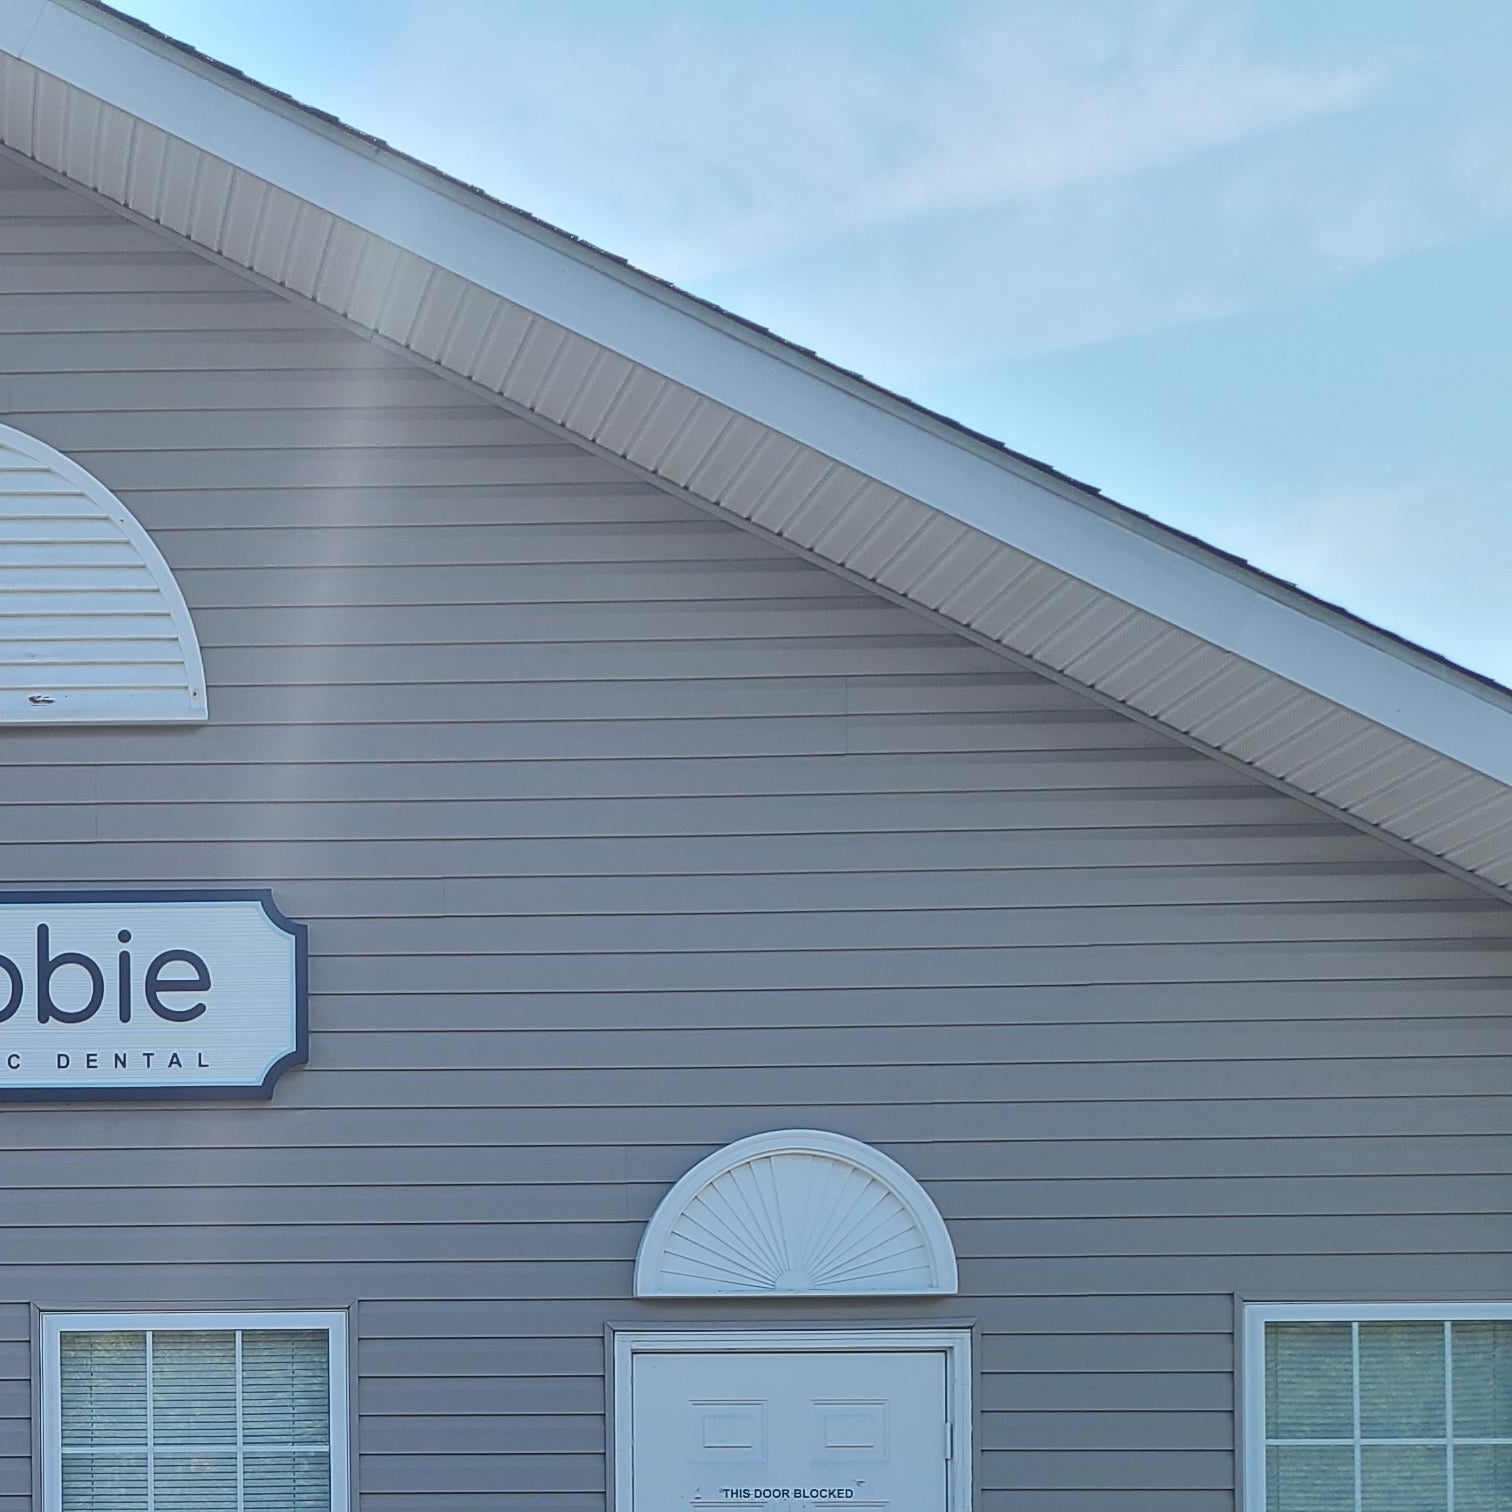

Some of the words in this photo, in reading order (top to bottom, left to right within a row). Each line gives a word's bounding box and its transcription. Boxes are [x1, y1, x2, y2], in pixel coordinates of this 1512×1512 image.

[56, 1052, 210, 1069] DENTAL
[723, 1488, 751, 1499] THIS
[753, 1488, 790, 1499] DOOR
[793, 1488, 854, 1499] BLOCKED
